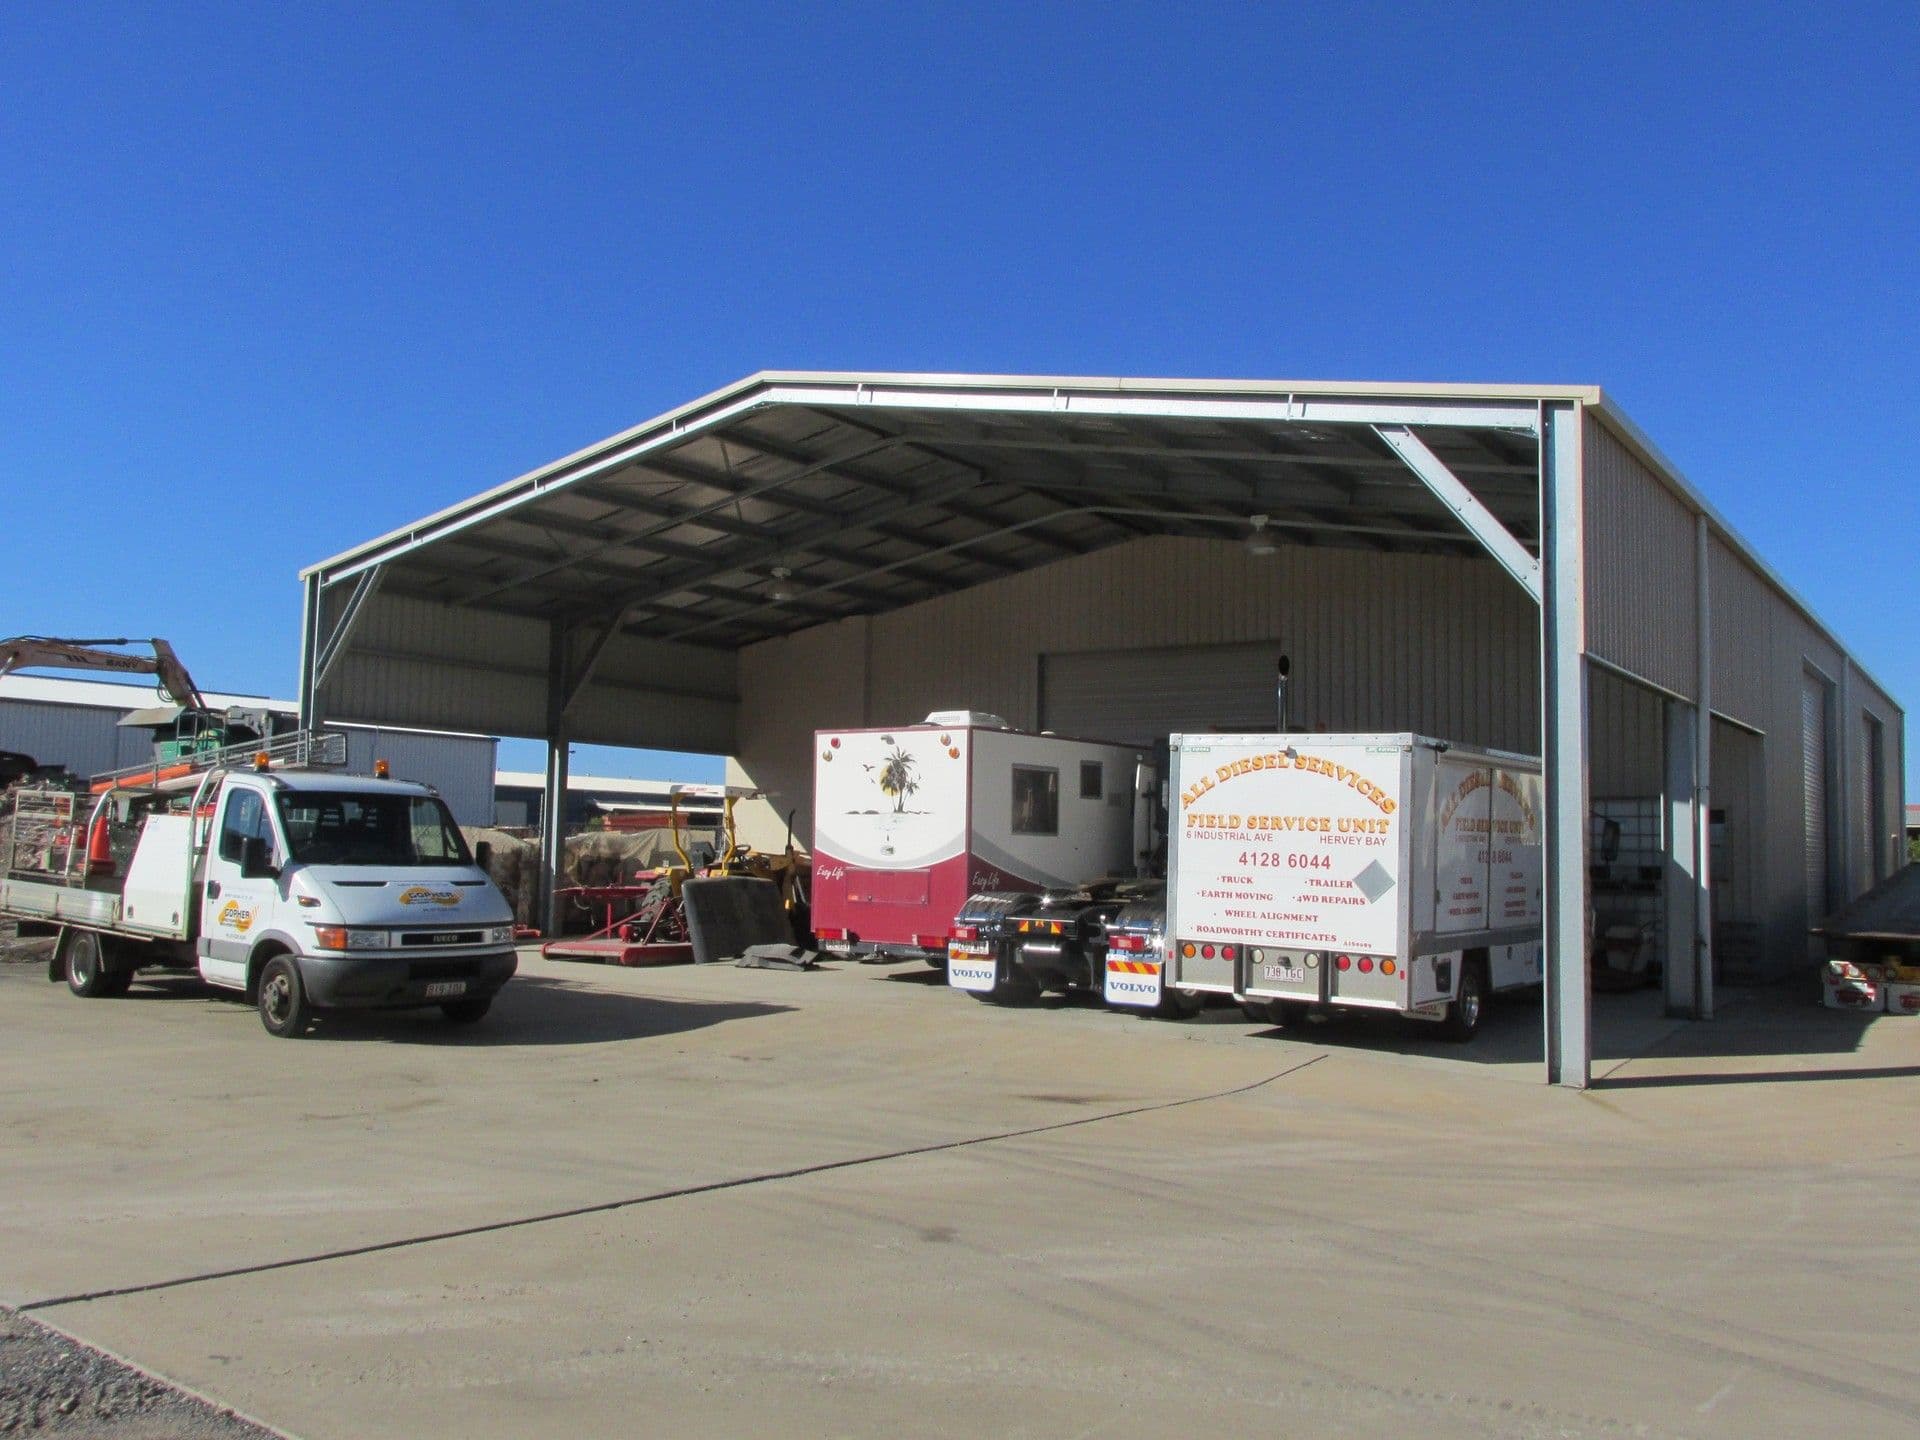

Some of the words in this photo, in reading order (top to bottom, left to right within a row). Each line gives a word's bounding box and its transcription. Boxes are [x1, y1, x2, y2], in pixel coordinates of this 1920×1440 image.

[1181, 776, 1215, 810] ALL
[1216, 753, 1288, 783] DIESEL
[1295, 754, 1397, 814] SERVICES
[1187, 813, 1242, 829] FIELD
[1247, 815, 1331, 832] SERVICE
[1338, 817, 1390, 834] UNIT
[1186, 831, 1191, 839] 6
[1194, 831, 1252, 841] INDUSTRIAL
[1254, 833, 1273, 842] AVE
[1320, 835, 1362, 846] HERVEY
[1365, 837, 1387, 846] BAY
[1238, 852, 1280, 867] 4128
[1288, 853, 1331, 870] 6044
[817, 864, 832, 880] Easy
[1221, 876, 1253, 884] TRUCK
[1309, 879, 1353, 888] TRAILER
[1201, 890, 1232, 899] EARTH
[1235, 892, 1273, 901] MOVING
[1296, 894, 1319, 903] 4WD
[1321, 896, 1365, 905] REPAIRS
[225, 908, 249, 919] GOPHER
[1225, 909, 1258, 919] WHEEL
[1260, 912, 1319, 922] ALIGNMENT
[433, 934, 457, 943] IVECO
[1196, 925, 1264, 936] ROADWORTHY
[1266, 930, 1337, 942] CERTIFICATES
[952, 969, 993, 979] VOLVO
[1110, 981, 1157, 993] VOLVO
